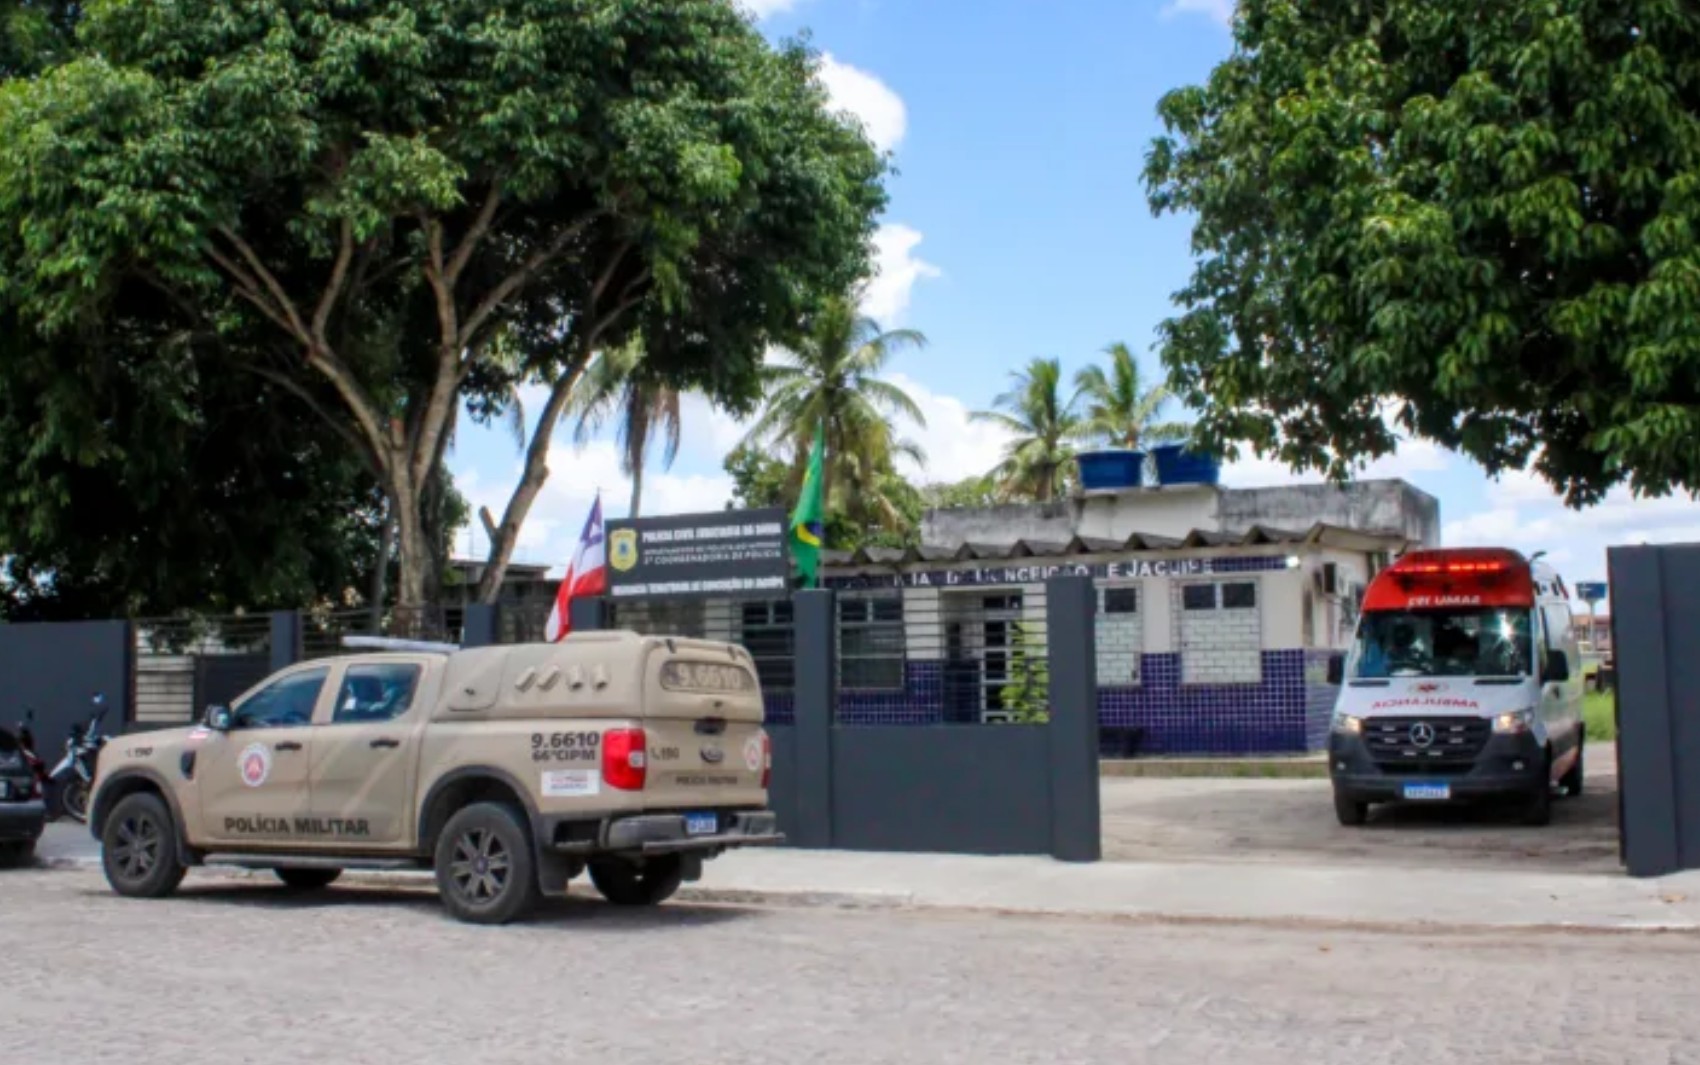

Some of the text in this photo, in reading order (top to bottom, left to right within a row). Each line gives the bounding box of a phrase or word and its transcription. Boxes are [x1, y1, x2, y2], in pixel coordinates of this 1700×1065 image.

[531, 731, 599, 748] 9.6610
[224, 815, 370, 836] POLÍCIA MILITAR
